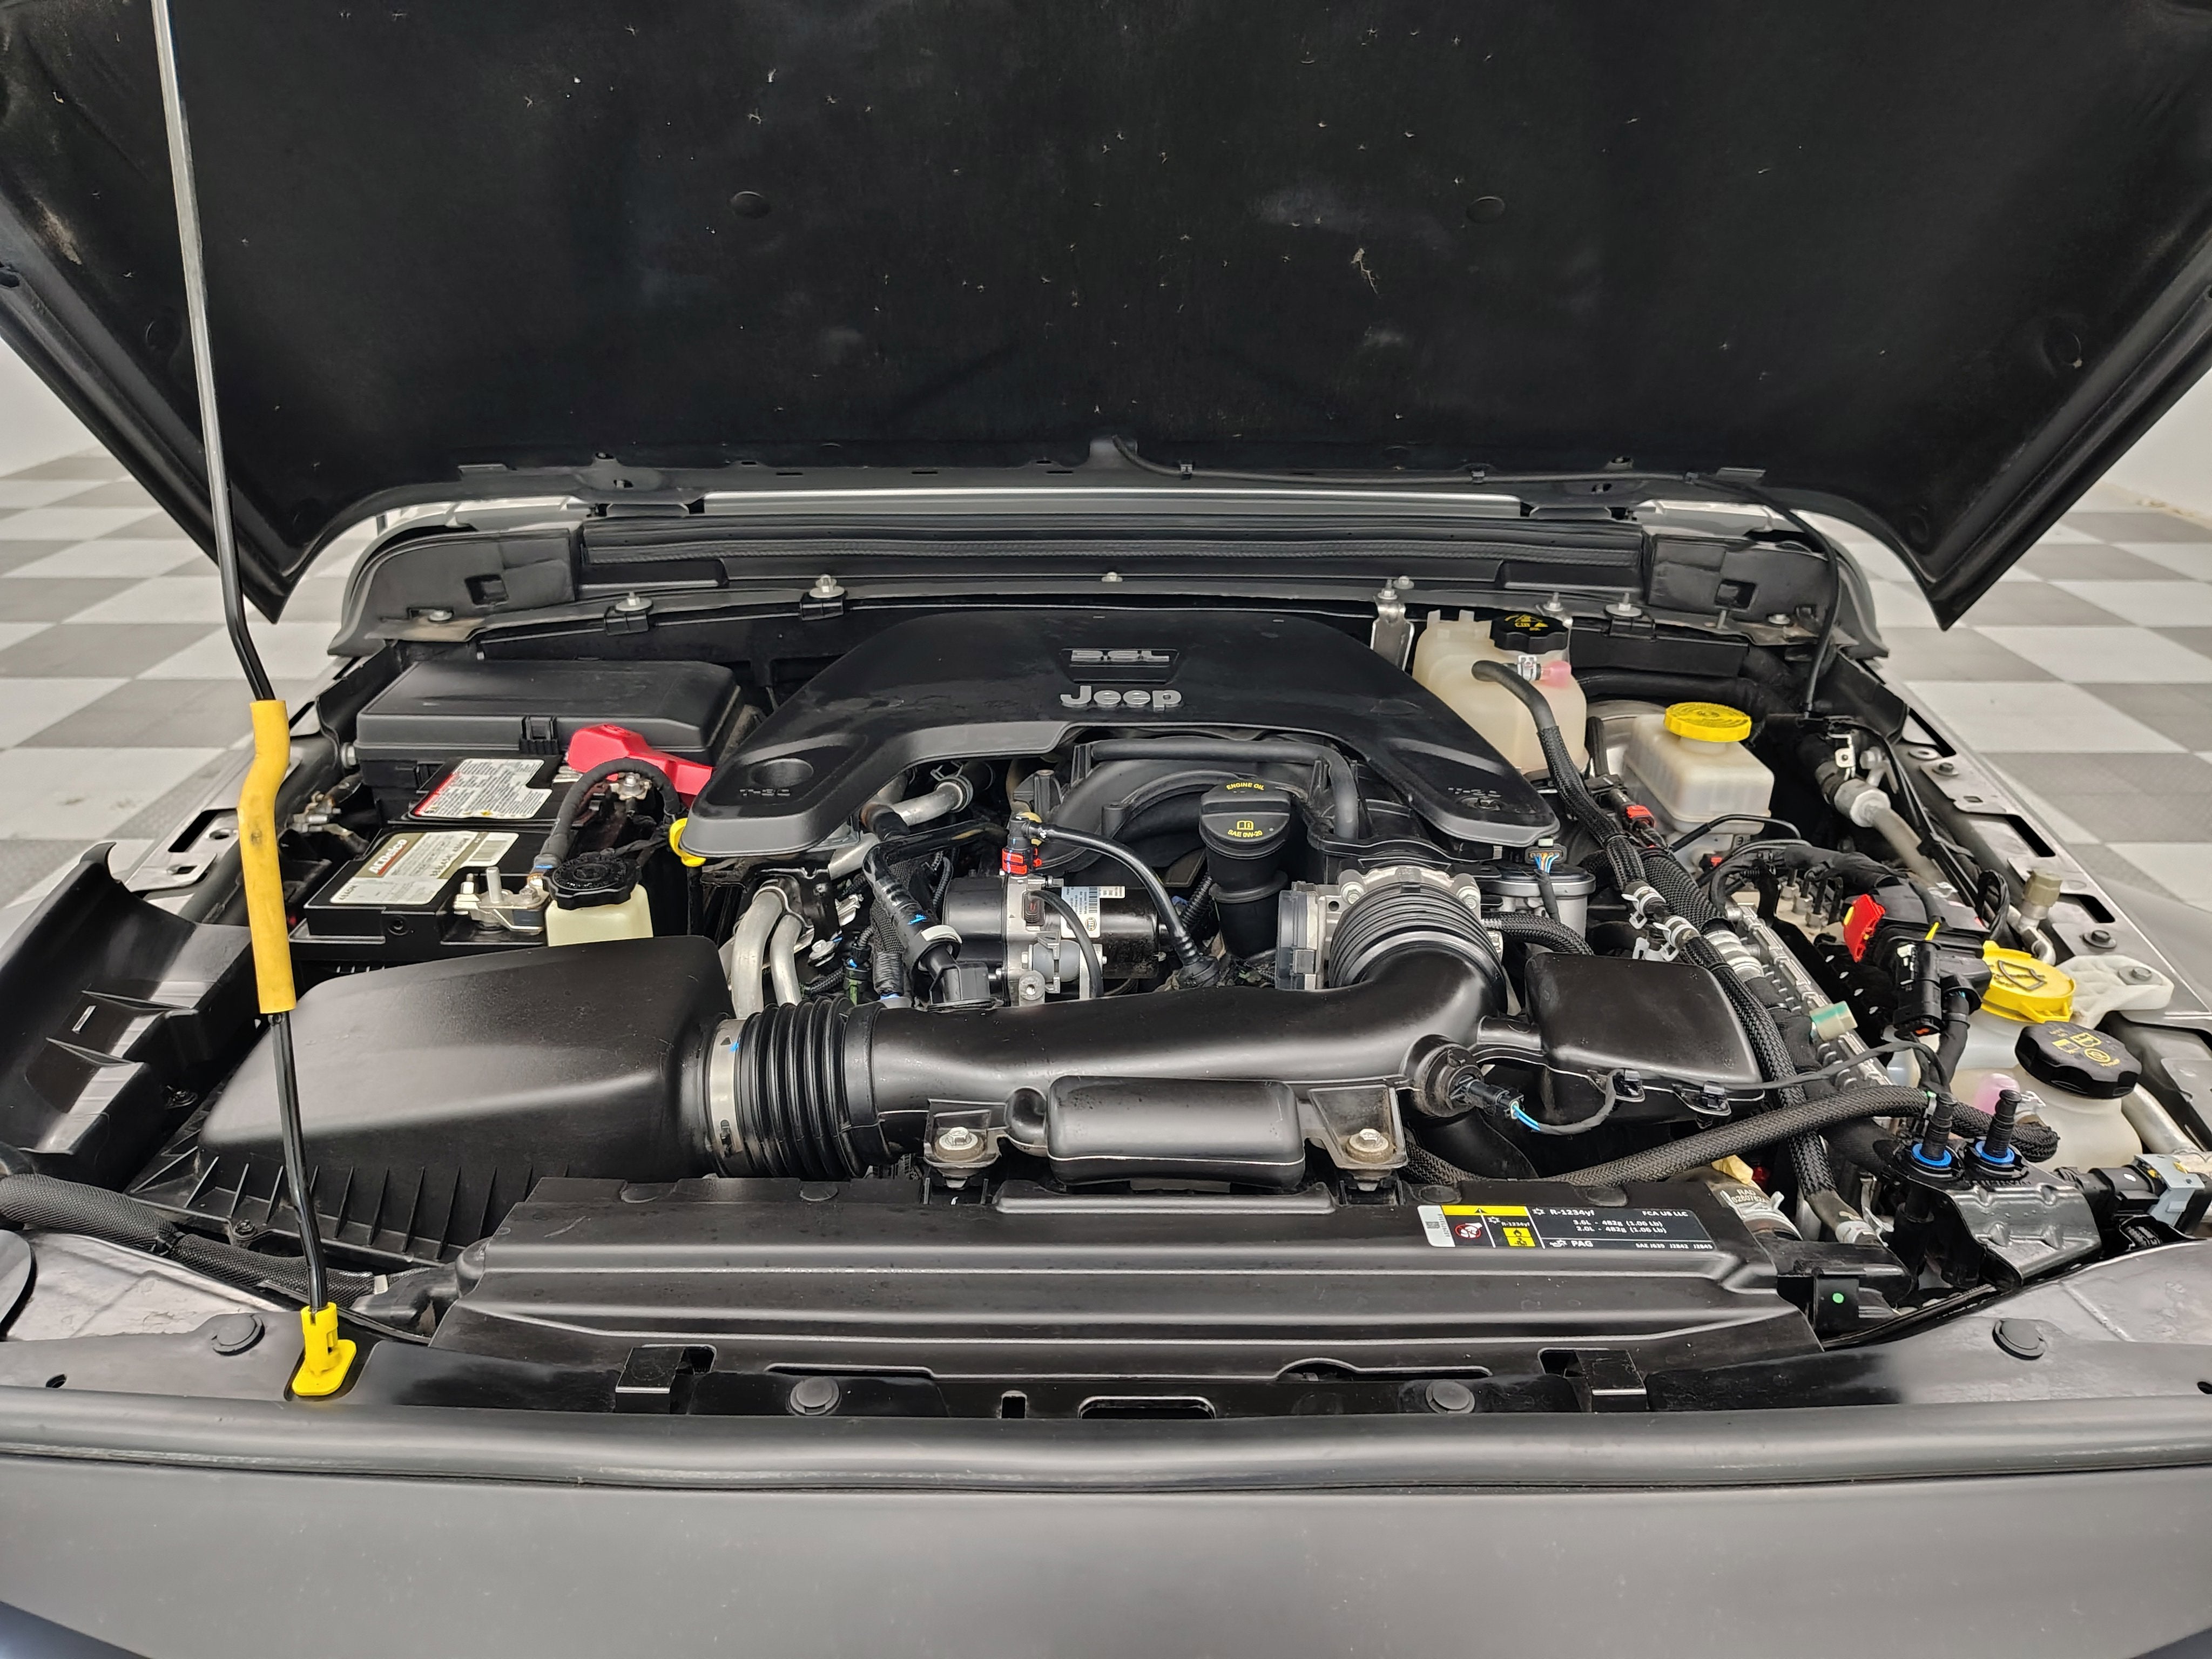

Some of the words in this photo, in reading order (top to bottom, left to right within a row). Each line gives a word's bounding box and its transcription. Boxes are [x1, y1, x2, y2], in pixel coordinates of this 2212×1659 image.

[1060, 685, 1182, 713] Jeep
[1226, 782, 1253, 790] ENGINE
[1227, 829, 1242, 838] SAE
[1243, 830, 1263, 838] 0W-20
[368, 839, 408, 874] ACDelco
